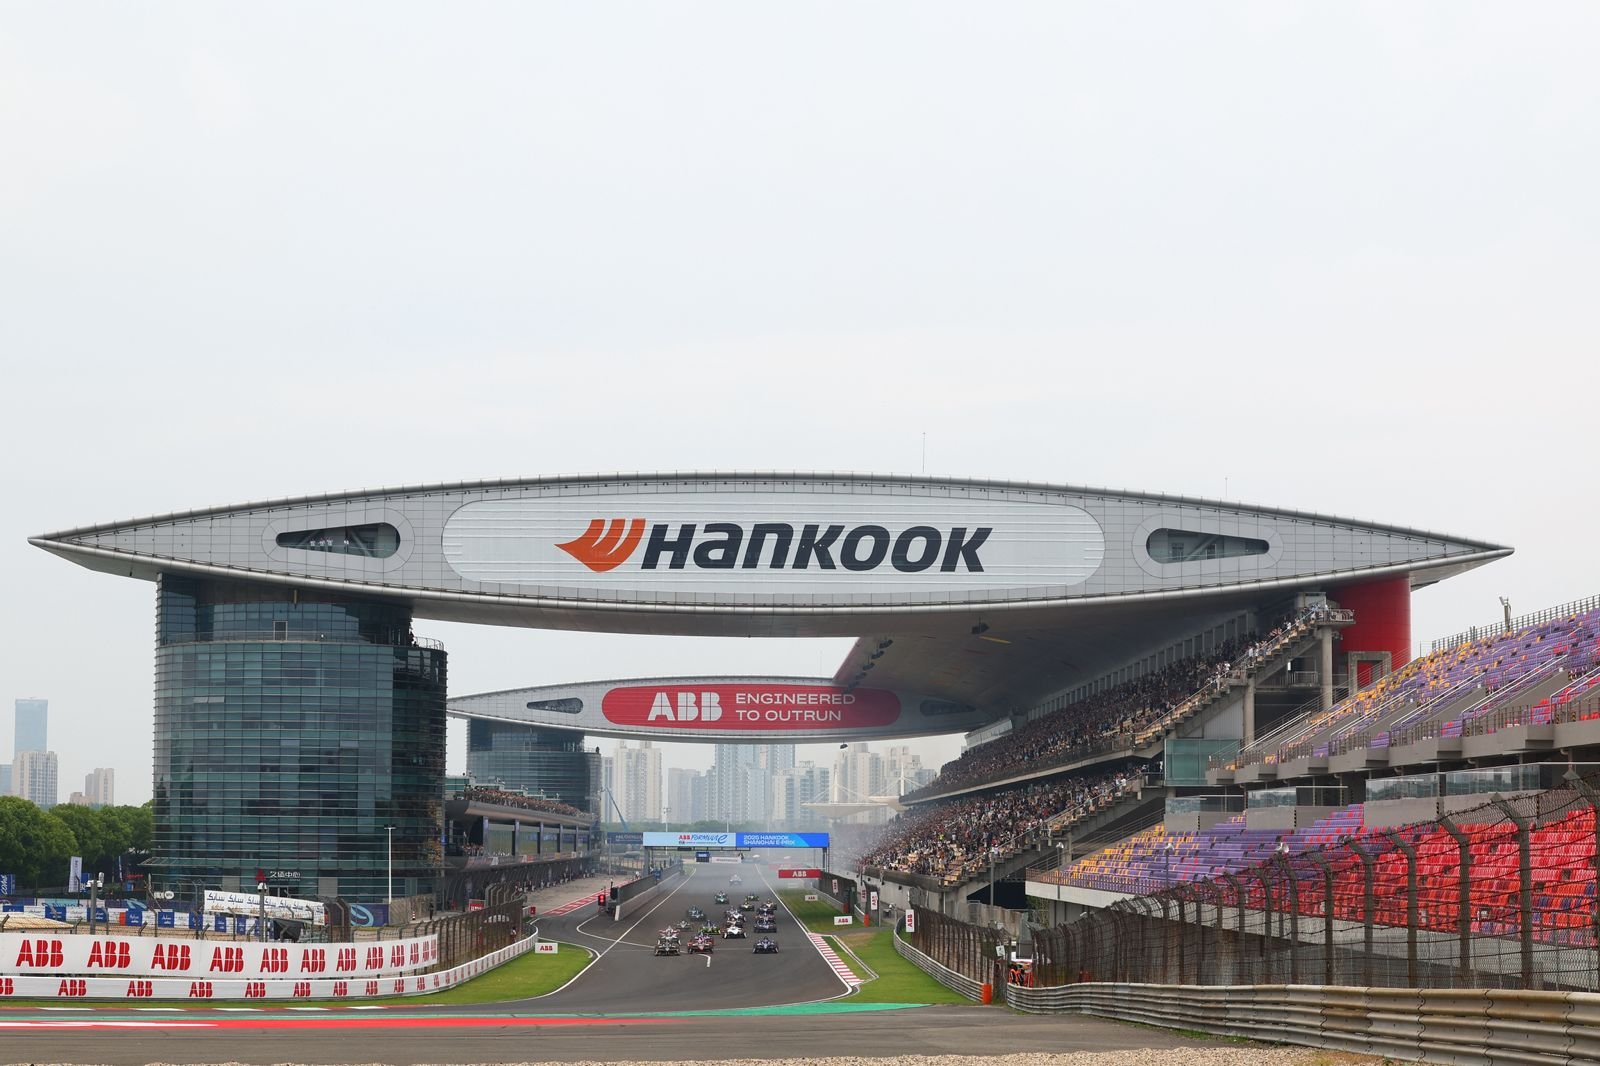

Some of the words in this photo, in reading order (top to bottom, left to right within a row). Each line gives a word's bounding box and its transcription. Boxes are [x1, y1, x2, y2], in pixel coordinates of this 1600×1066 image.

[647, 691, 723, 722] ABB
[735, 693, 856, 705] ENGINEERED
[735, 710, 760, 721] TO
[765, 710, 842, 721] OUTRUN
[792, 870, 807, 878] ABB
[16, 939, 64, 968] ABB
[87, 940, 131, 969] ABB
[151, 943, 191, 971] ABB
[209, 946, 244, 973] ABB
[260, 948, 288, 973] ABB
[301, 948, 326, 973] ABB
[336, 948, 357, 972] ABB
[366, 946, 384, 970] ABB
[391, 945, 405, 968] ABB
[58, 979, 87, 997] ABB
[127, 980, 153, 997] ABB
[189, 981, 213, 998] ABB
[245, 982, 266, 998] ABB
[293, 982, 311, 997] ABB
[333, 981, 348, 996] ABB
[366, 981, 378, 995] ABB
